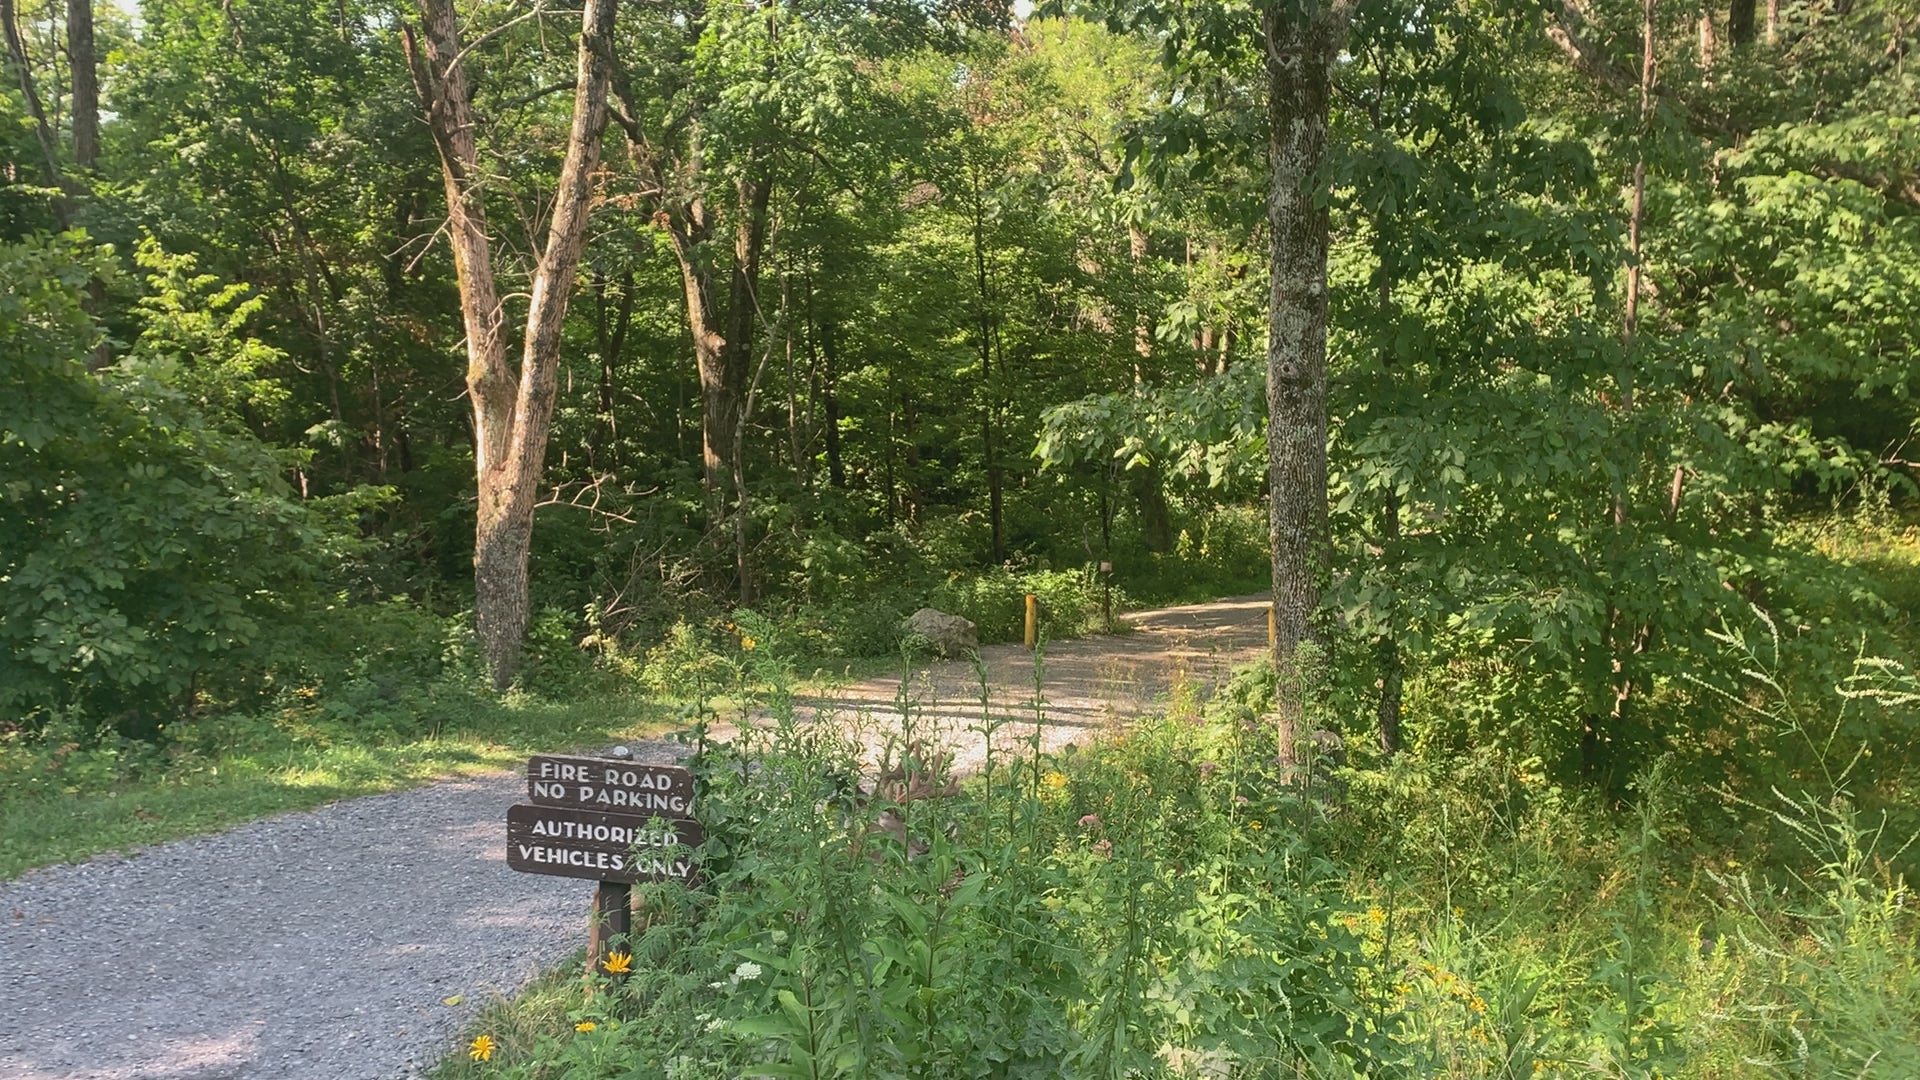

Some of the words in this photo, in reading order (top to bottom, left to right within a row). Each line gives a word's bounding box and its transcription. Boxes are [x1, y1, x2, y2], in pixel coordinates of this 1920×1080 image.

[540, 762, 589, 783] FIRE
[605, 769, 672, 791] ROAD
[534, 782, 566, 799] NO
[579, 786, 685, 813] PARKING
[518, 844, 624, 872] VEHICLES
[636, 857, 692, 878] ONLY
